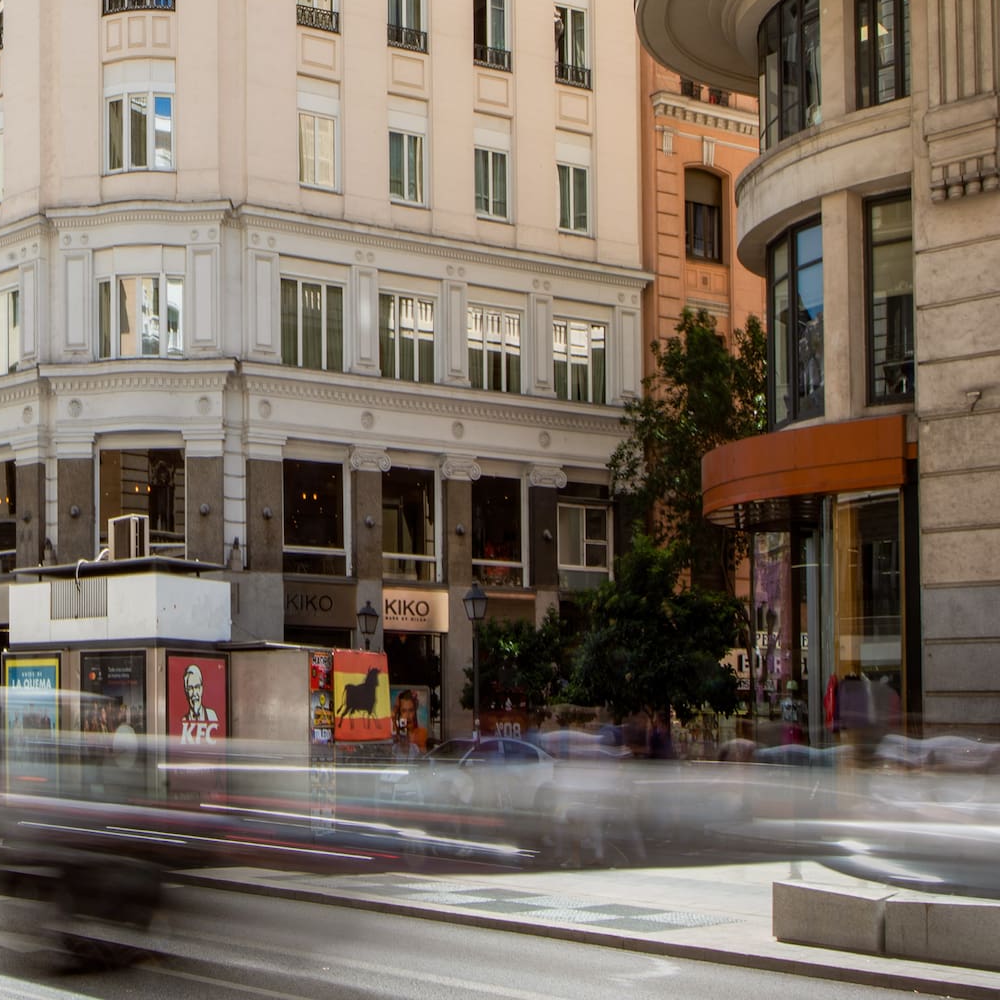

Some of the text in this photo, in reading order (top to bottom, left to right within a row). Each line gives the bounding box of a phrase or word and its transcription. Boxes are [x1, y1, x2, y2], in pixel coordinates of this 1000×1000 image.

[286, 593, 333, 612] KIKO
[385, 599, 430, 617] KIKO
[12, 677, 52, 689] LA QUEMA
[181, 722, 219, 745] KFC
